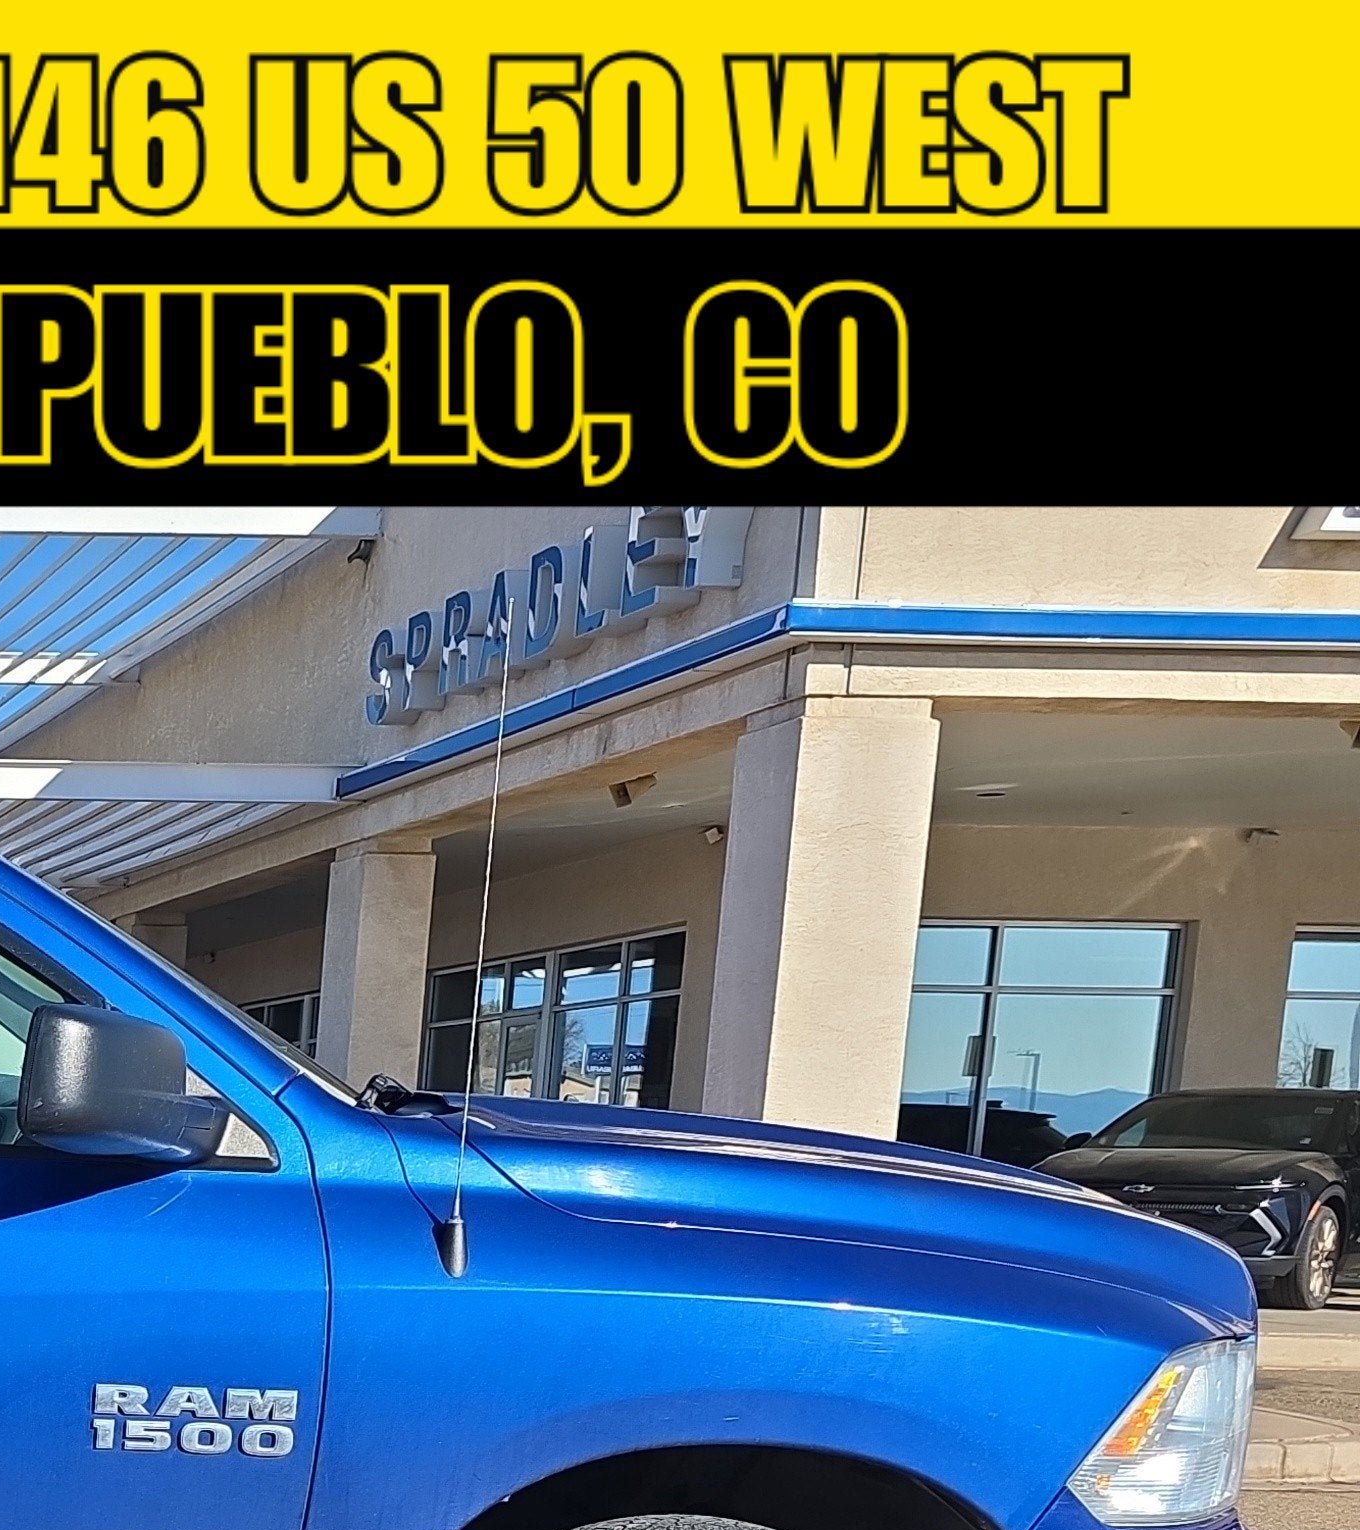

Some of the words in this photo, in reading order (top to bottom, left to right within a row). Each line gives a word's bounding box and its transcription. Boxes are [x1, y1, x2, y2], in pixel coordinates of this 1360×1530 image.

[366, 506, 720, 725] SPRADLEY
[92, 1383, 299, 1421] RAM
[91, 1418, 294, 1458] 1500
